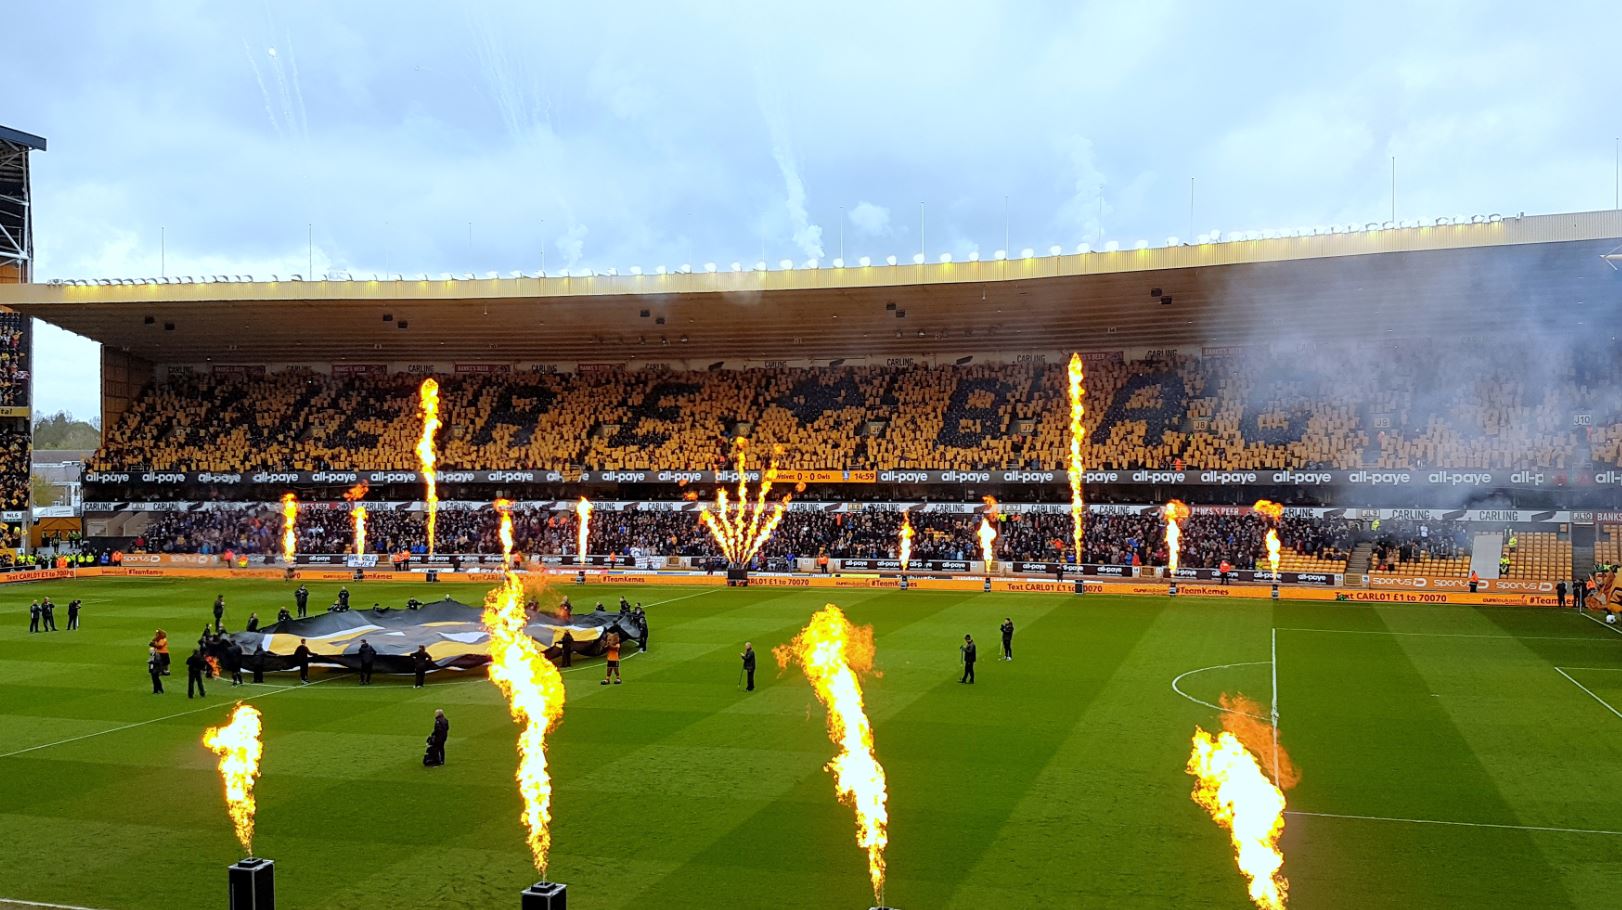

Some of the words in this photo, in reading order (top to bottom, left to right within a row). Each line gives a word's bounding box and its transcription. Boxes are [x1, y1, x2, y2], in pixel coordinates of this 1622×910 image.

[886, 357, 914, 367] CARLING
[1016, 354, 1046, 364] CARLING
[407, 364, 434, 373] CARLING
[1376, 418, 1388, 427] J9
[1574, 415, 1591, 424] J10
[85, 472, 130, 484] all-paye
[142, 472, 186, 484] all-paye
[198, 473, 241, 485] all-paye
[252, 472, 299, 484] all-paye
[312, 472, 357, 483] all-paye
[370, 472, 417, 483] all-paye
[488, 471, 534, 483] all-paye
[602, 471, 645, 483] all-paye
[658, 471, 702, 483] all-paye
[881, 471, 928, 483] all-paye
[941, 471, 990, 483] all-paye
[1003, 471, 1054, 483] all-paye
[1132, 471, 1186, 484] all-paye
[1200, 471, 1257, 484] all-paye
[1273, 471, 1332, 485] all-paye
[1349, 471, 1410, 485] all-paye
[1428, 471, 1492, 486] all-paye
[84, 502, 112, 511] CARLING
[648, 502, 674, 511] CARLING
[792, 503, 820, 512] CARLING
[936, 503, 965, 513] CARLING
[1031, 504, 1061, 514] CARLING
[1099, 505, 1130, 515] CARLING
[1284, 508, 1314, 518] ARLING
[1392, 509, 1430, 520] CARLING
[1479, 510, 1518, 521] CARLING
[876, 560, 899, 568] all-paye
[941, 561, 965, 569] all-paye
[1097, 566, 1122, 574] all-paye
[6, 573, 18, 581] Text
[602, 575, 646, 583] #TeamKemes
[788, 578, 810, 586] 70070
[1297, 573, 1326, 582] all-paye
[1008, 583, 1024, 591] Text
[1025, 583, 1054, 592] CARL01
[1056, 584, 1066, 592] £1
[1083, 584, 1103, 593] 0070
[1356, 592, 1391, 601] CARL01
[1393, 593, 1404, 601] £1
[1406, 594, 1416, 602] to
[1419, 594, 1447, 602] 70070
